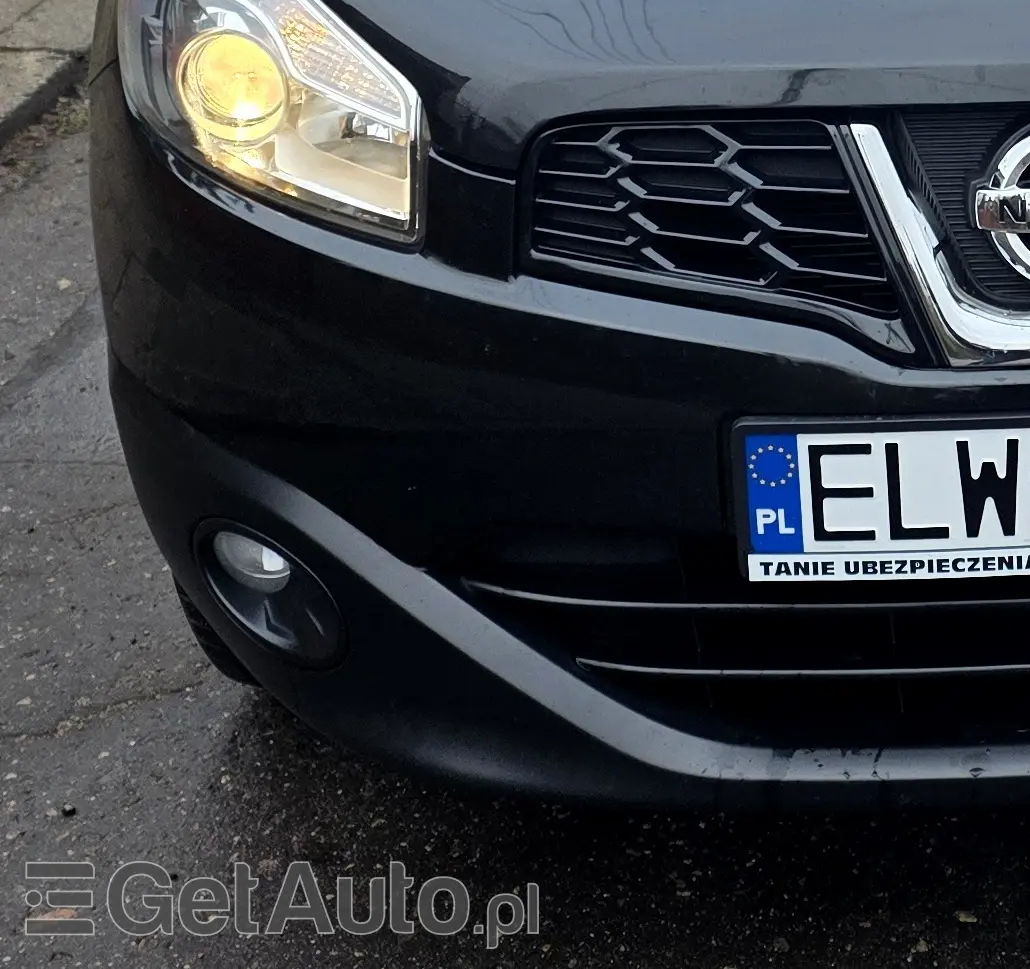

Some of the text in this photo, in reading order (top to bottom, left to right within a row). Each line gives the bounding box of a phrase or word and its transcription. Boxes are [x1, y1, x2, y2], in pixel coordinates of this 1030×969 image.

[807, 438, 1019, 541] ELW
[756, 508, 796, 535] PL
[760, 560, 835, 576] TANIE
